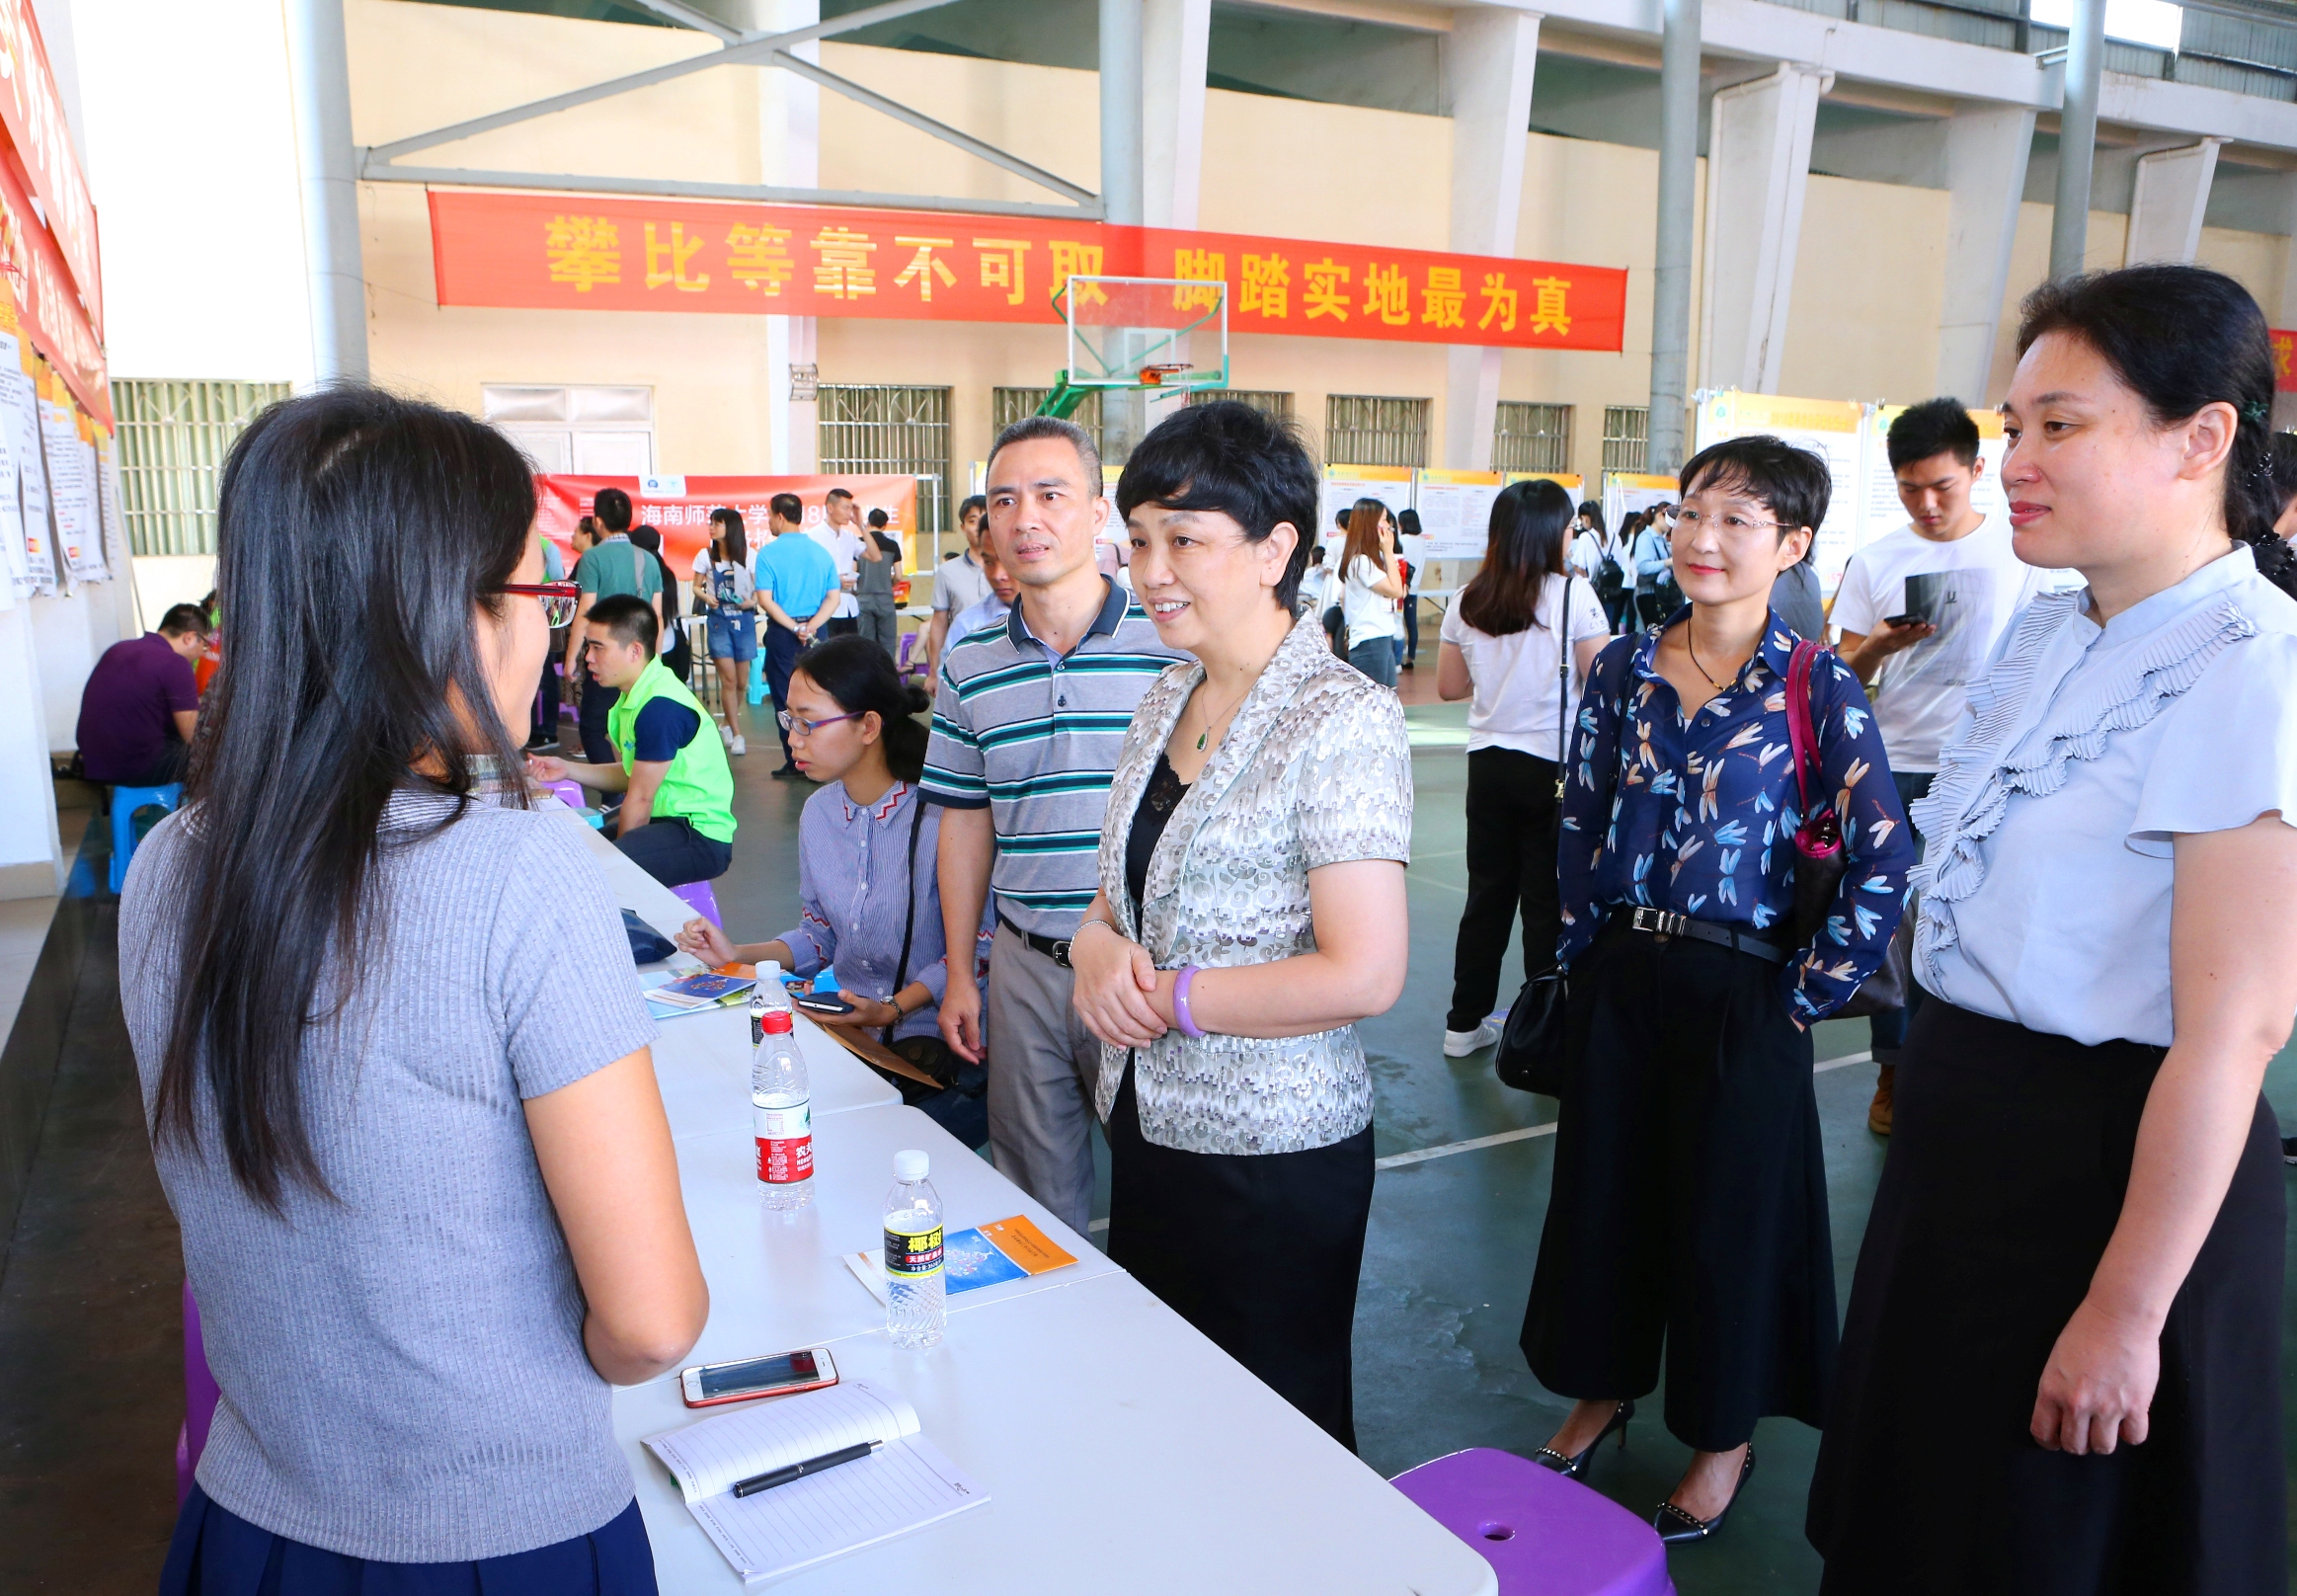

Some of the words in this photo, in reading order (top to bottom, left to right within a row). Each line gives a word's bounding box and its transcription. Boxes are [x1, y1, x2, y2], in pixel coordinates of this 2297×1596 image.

[544, 214, 1108, 307] 攀比等靠不可取
[1172, 248, 1572, 336] 脚踏实地最为真
[908, 1230, 942, 1253] 椰树
